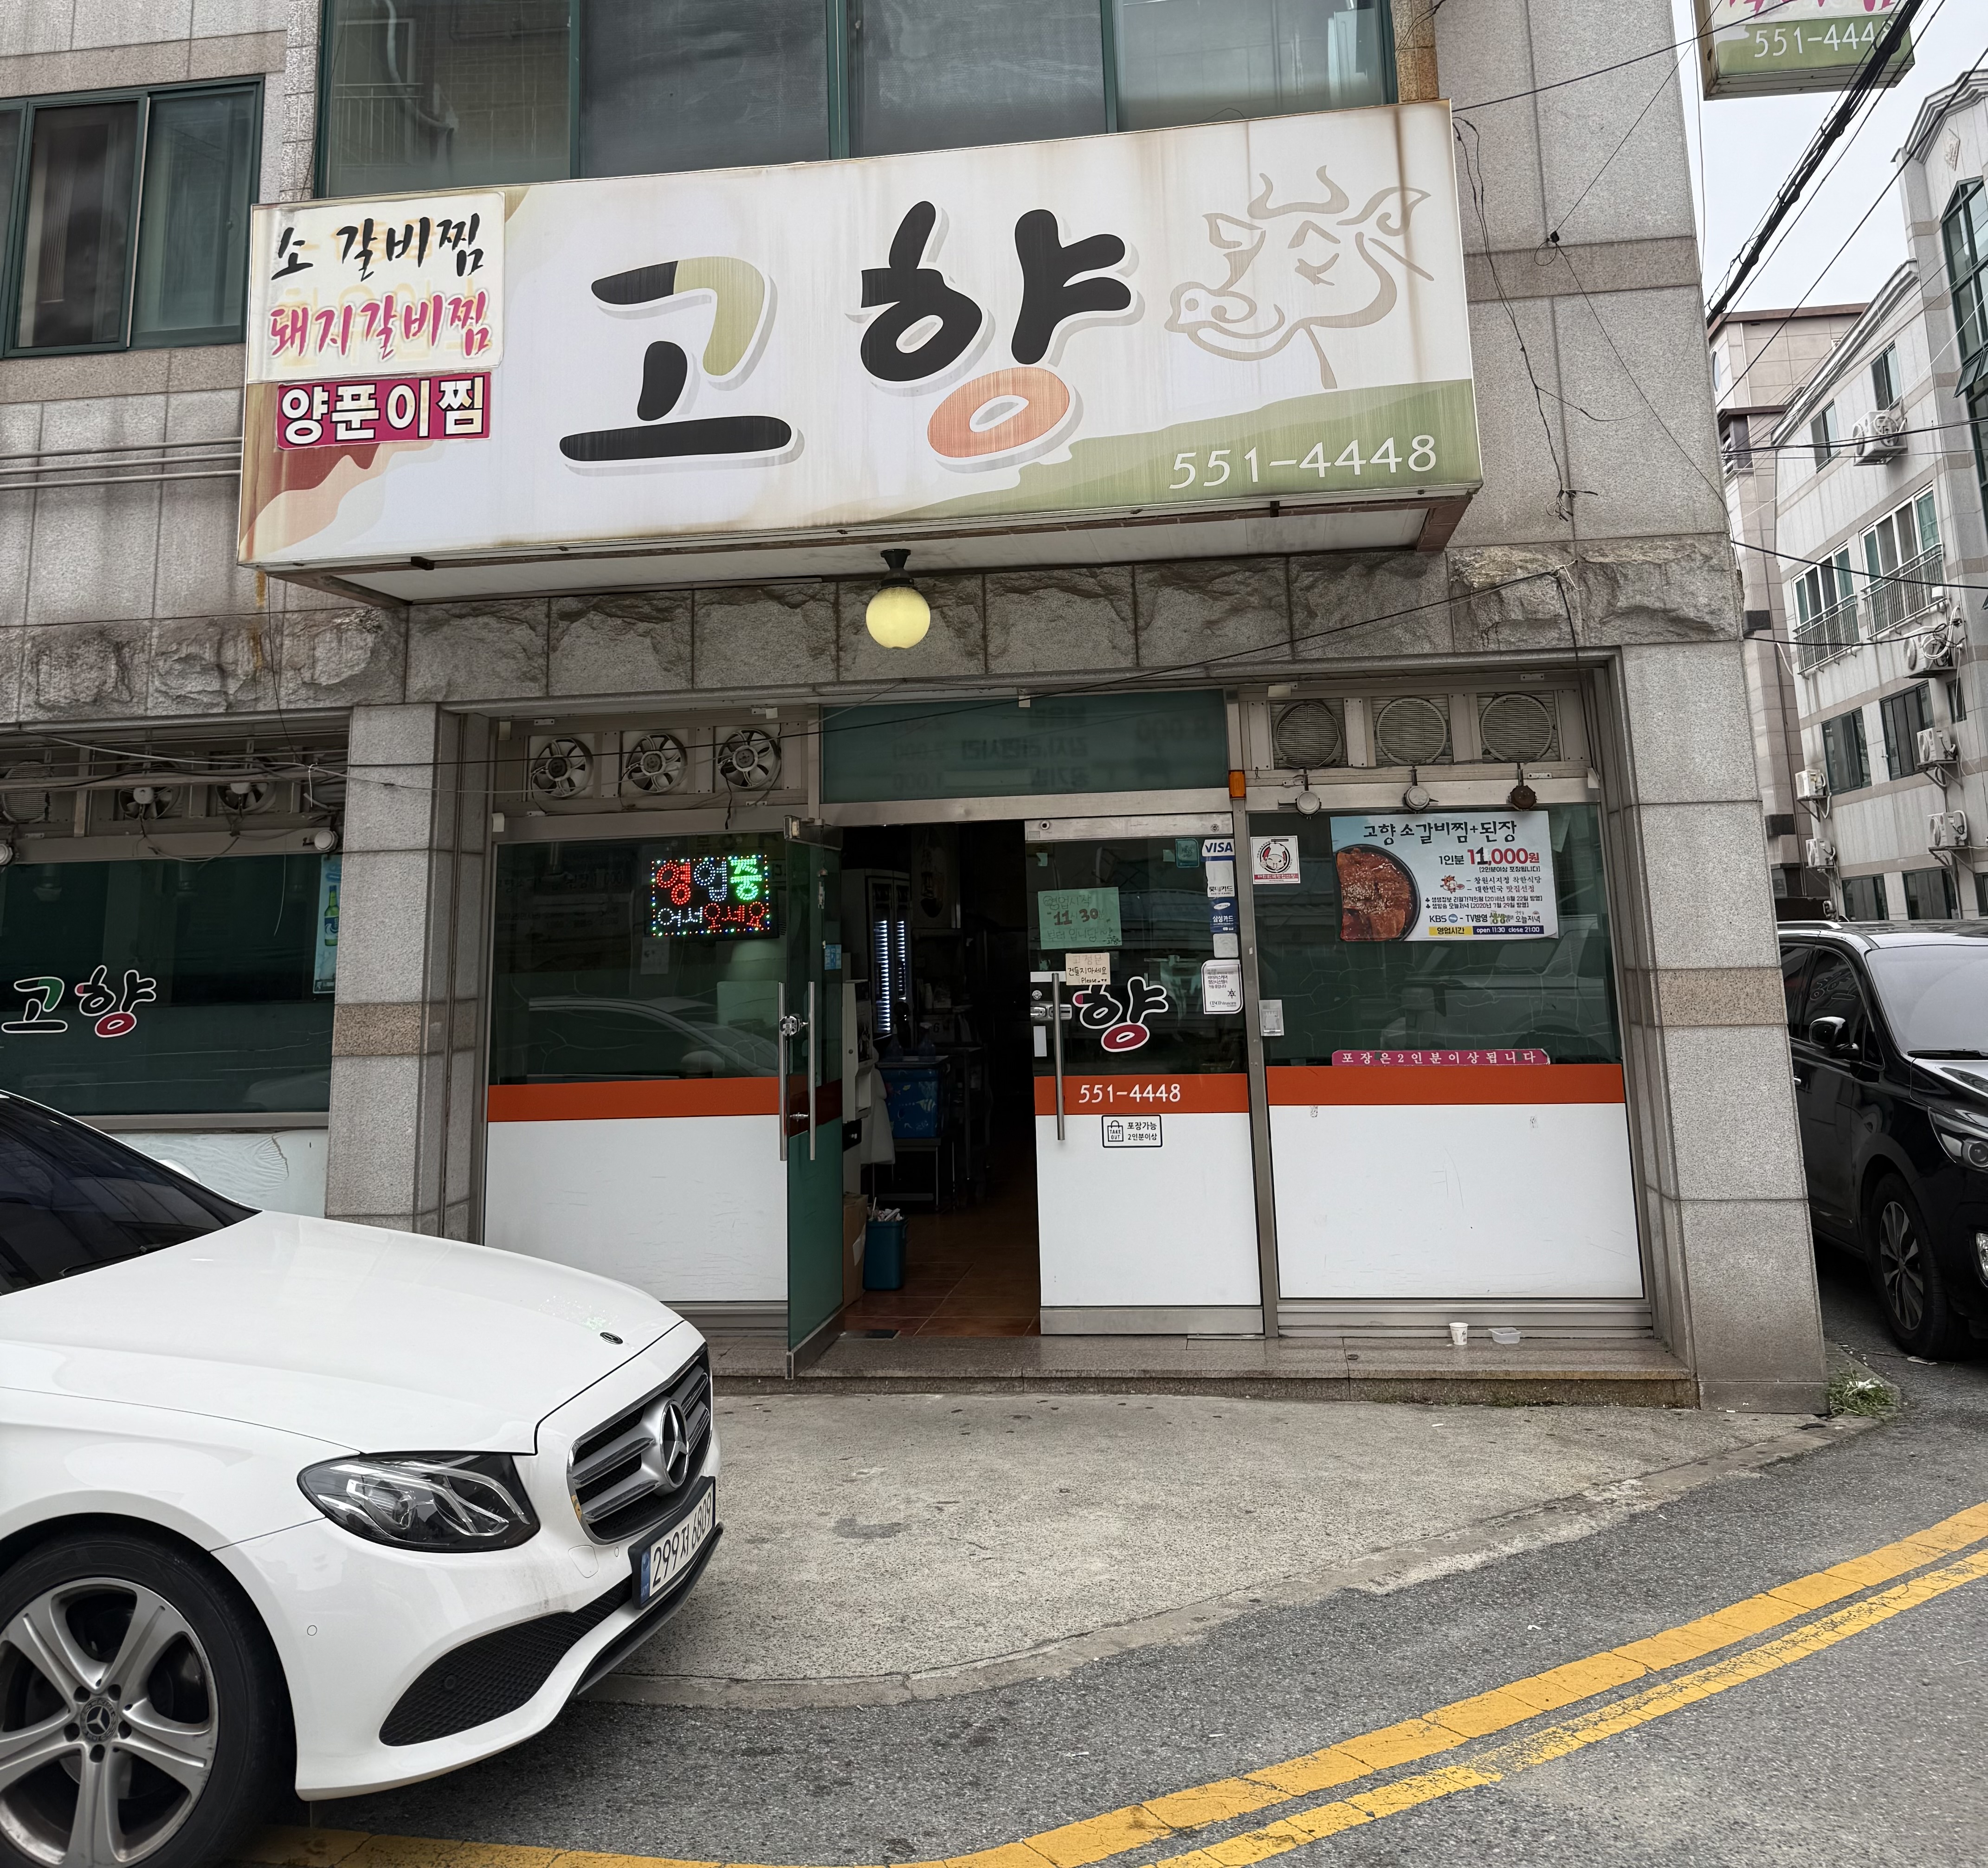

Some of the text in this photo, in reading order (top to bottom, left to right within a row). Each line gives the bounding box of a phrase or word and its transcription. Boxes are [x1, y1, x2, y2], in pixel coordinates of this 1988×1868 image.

[271, 213, 484, 281] 소 갈비찜
[270, 291, 490, 361] 돼지갈비찜
[559, 200, 1132, 462] 고향
[280, 376, 484, 444] 양푼이찜
[1169, 434, 1436, 489] 551-4448
[1205, 842, 1233, 852] VISA
[1363, 821, 1517, 845] 고향 소갈비찜+된장
[1439, 847, 1540, 866] 1인분 11,000원
[656, 858, 762, 905] 영업중
[1465, 914, 1488, 922] TV방영
[1515, 915, 1541, 924] 오늘저녁
[1068, 967, 1107, 976] 건들지마세요
[1, 965, 157, 1038] 고향
[1072, 976, 1168, 1052] 향
[1078, 1084, 1181, 1103] 551-4448
[1127, 1122, 1157, 1130] 포장가능
[652, 1523, 689, 1589] 299저
